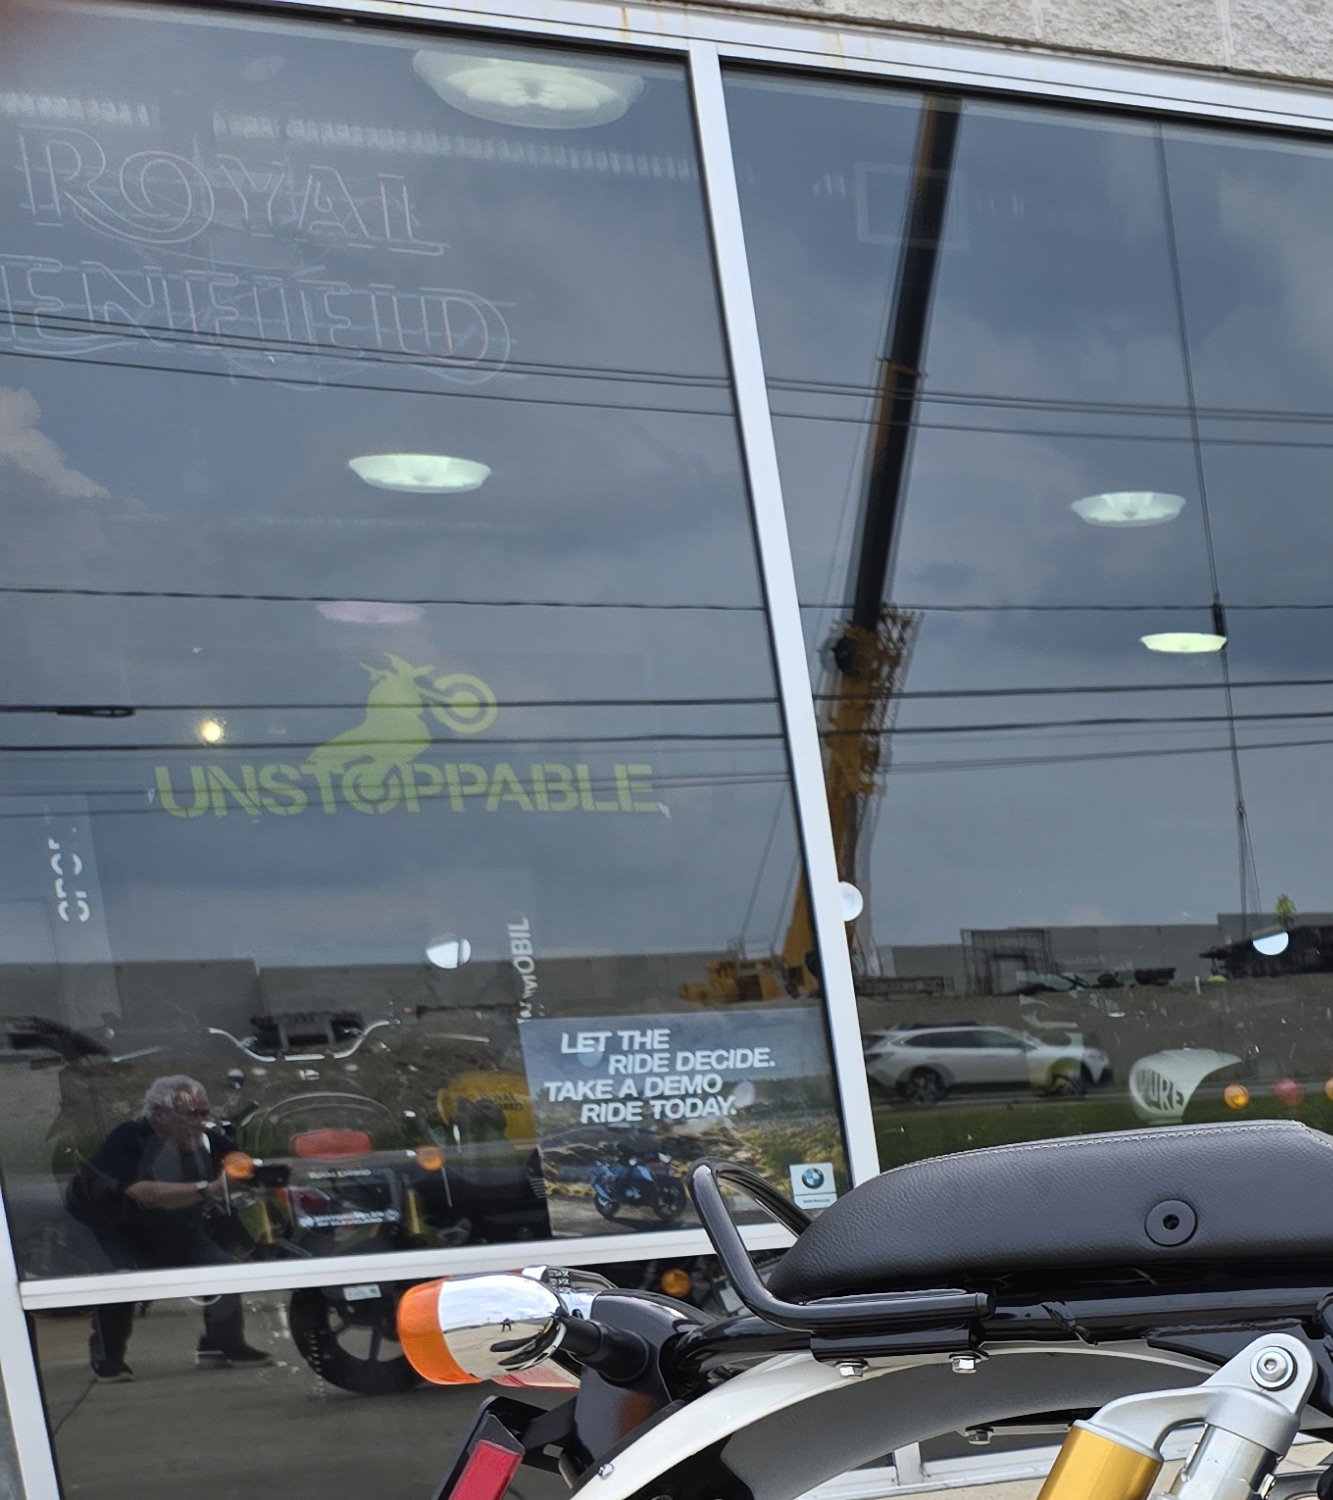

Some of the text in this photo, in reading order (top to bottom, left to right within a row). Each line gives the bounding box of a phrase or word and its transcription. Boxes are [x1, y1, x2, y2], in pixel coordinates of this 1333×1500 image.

[17, 122, 450, 256] ROYAL
[0, 253, 512, 385] ENFIELD
[155, 762, 660, 818] UNSTOPPABLE
[561, 1028, 671, 1054] LET THE
[608, 1047, 776, 1075] RIDE DECIDE.
[544, 1079, 614, 1102] TAKE
[619, 1078, 638, 1098] A
[644, 1073, 723, 1098] DEMO
[581, 1095, 738, 1124] RIDE TODAY.
